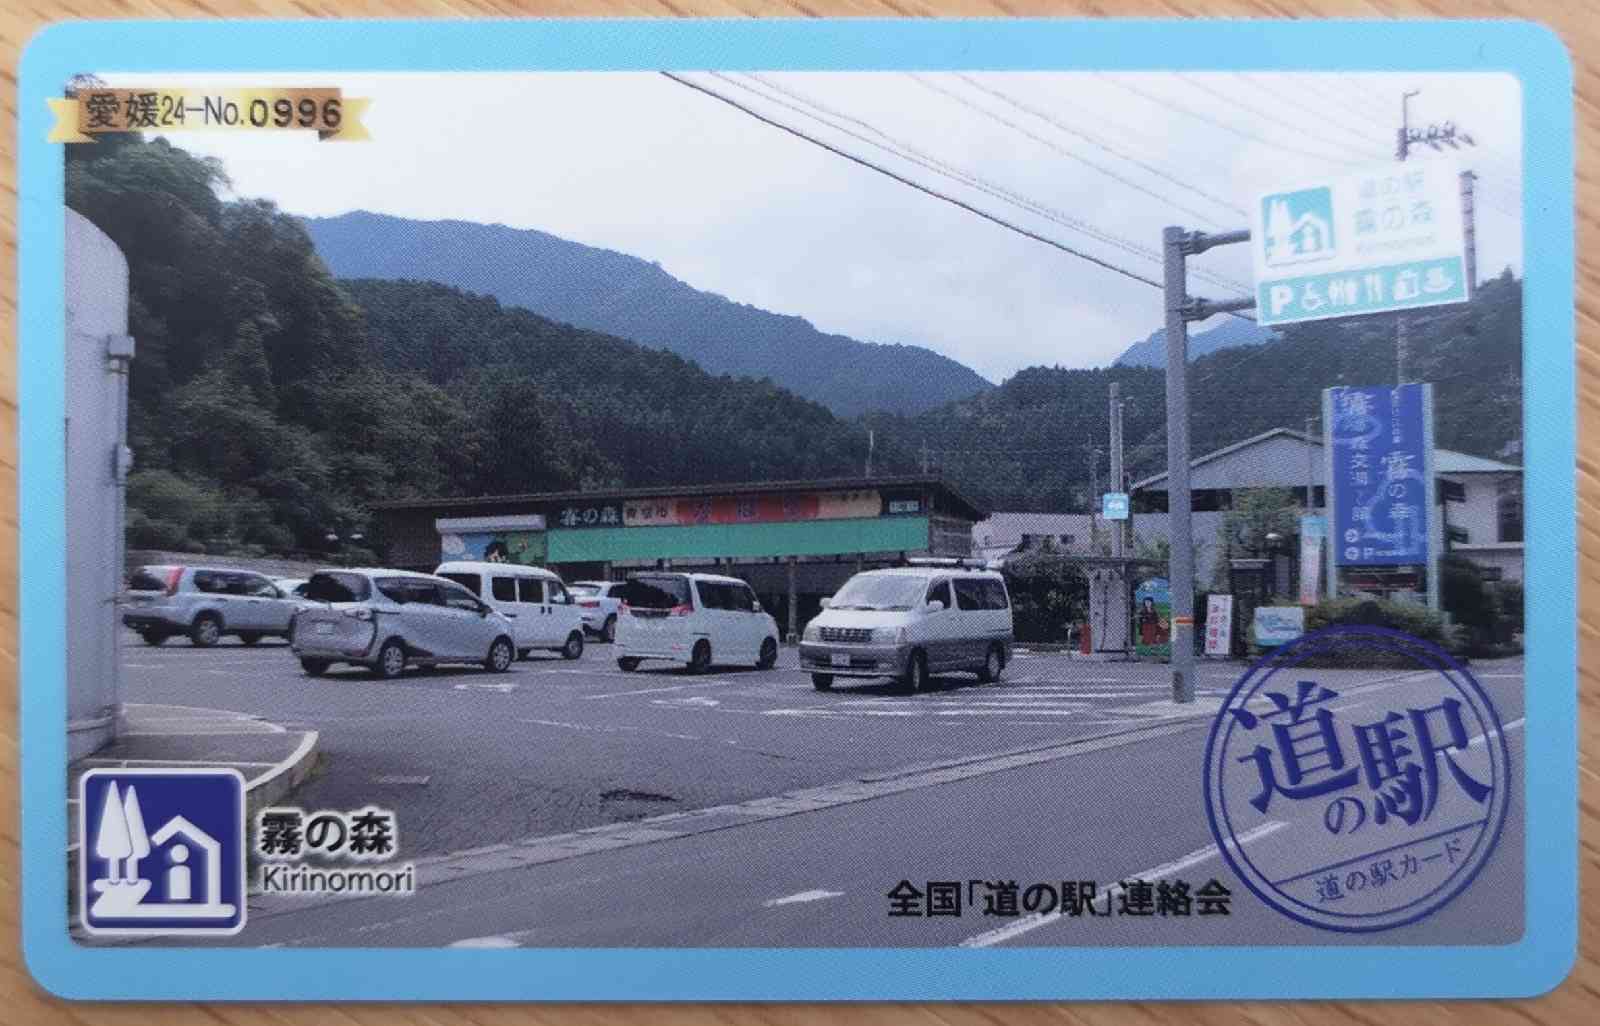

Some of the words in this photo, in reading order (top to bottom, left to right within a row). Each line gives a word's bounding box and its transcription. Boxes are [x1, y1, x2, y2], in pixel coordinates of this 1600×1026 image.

[260, 810, 394, 855] 霧の森
[262, 866, 414, 892] Kirinomori
[1315, 839, 1465, 902] 道の駅カード
[887, 880, 1233, 917] 全国「道の駅」連絡会
